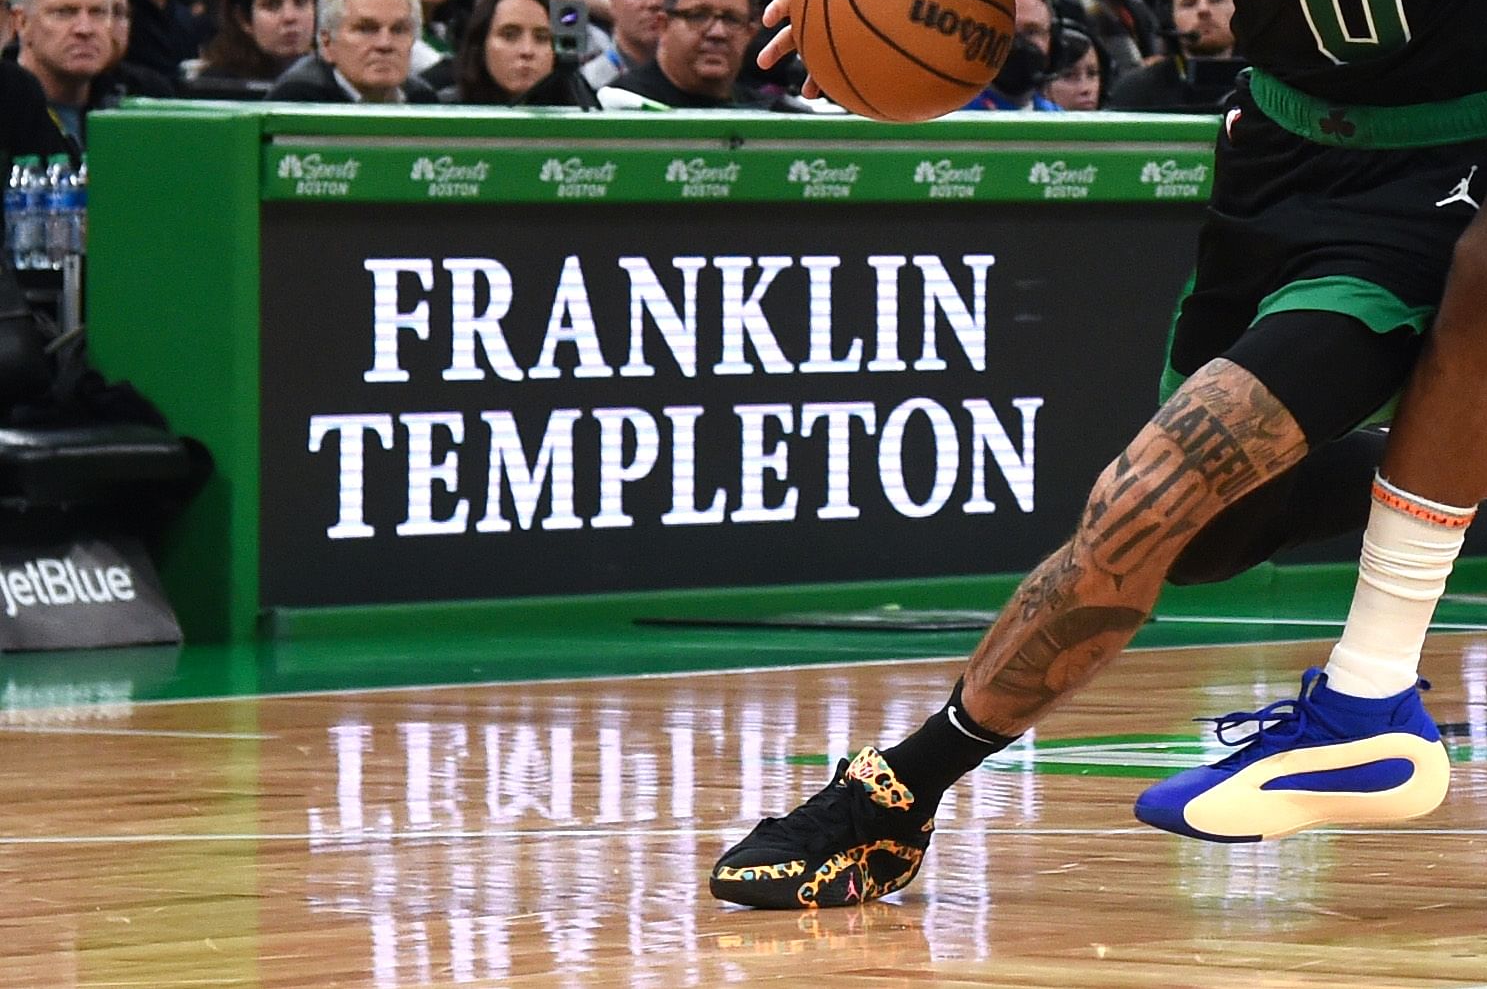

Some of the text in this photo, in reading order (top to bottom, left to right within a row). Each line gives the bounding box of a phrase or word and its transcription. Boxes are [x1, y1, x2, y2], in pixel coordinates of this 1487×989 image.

[296, 180, 349, 195] BOSTON
[428, 182, 480, 197] BOSTON
[557, 183, 607, 198] BOSTON
[682, 184, 730, 198] BOSTON
[803, 184, 850, 198] BOSTON
[930, 184, 975, 198] BOSTON
[1044, 185, 1089, 199] BOSTON
[1155, 185, 1200, 198] BOSTON
[364, 255, 996, 383] FRANKLIN
[308, 397, 1045, 540] TEMPLETON
